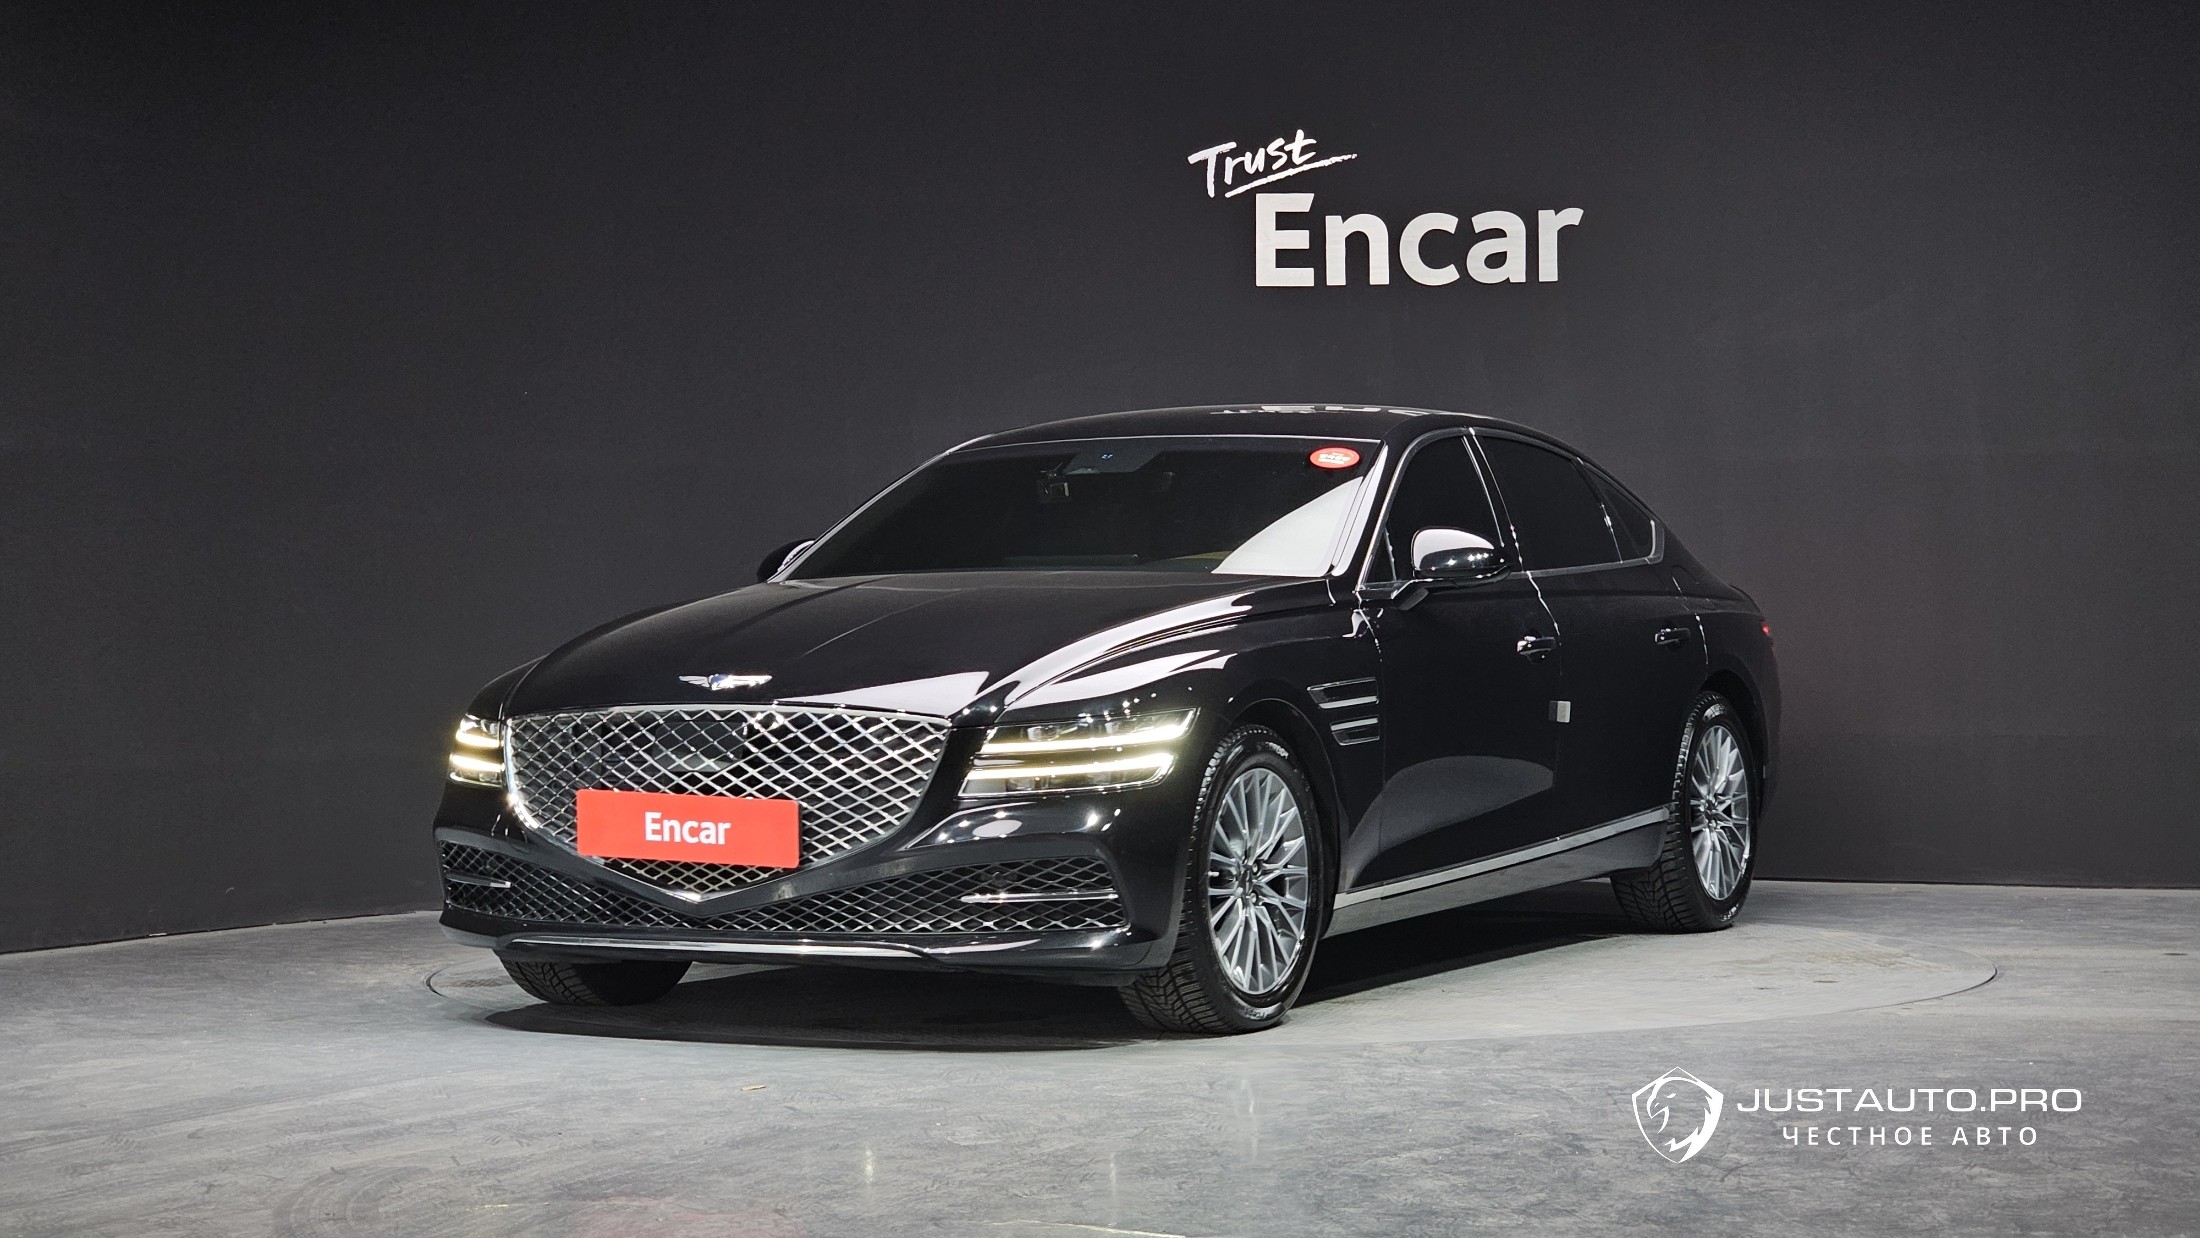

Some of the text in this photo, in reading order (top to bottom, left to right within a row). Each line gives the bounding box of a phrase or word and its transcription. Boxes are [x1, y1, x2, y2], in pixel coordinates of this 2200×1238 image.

[1188, 129, 1317, 198] Trust
[1255, 192, 1584, 287] Encar
[644, 811, 732, 845] Encar
